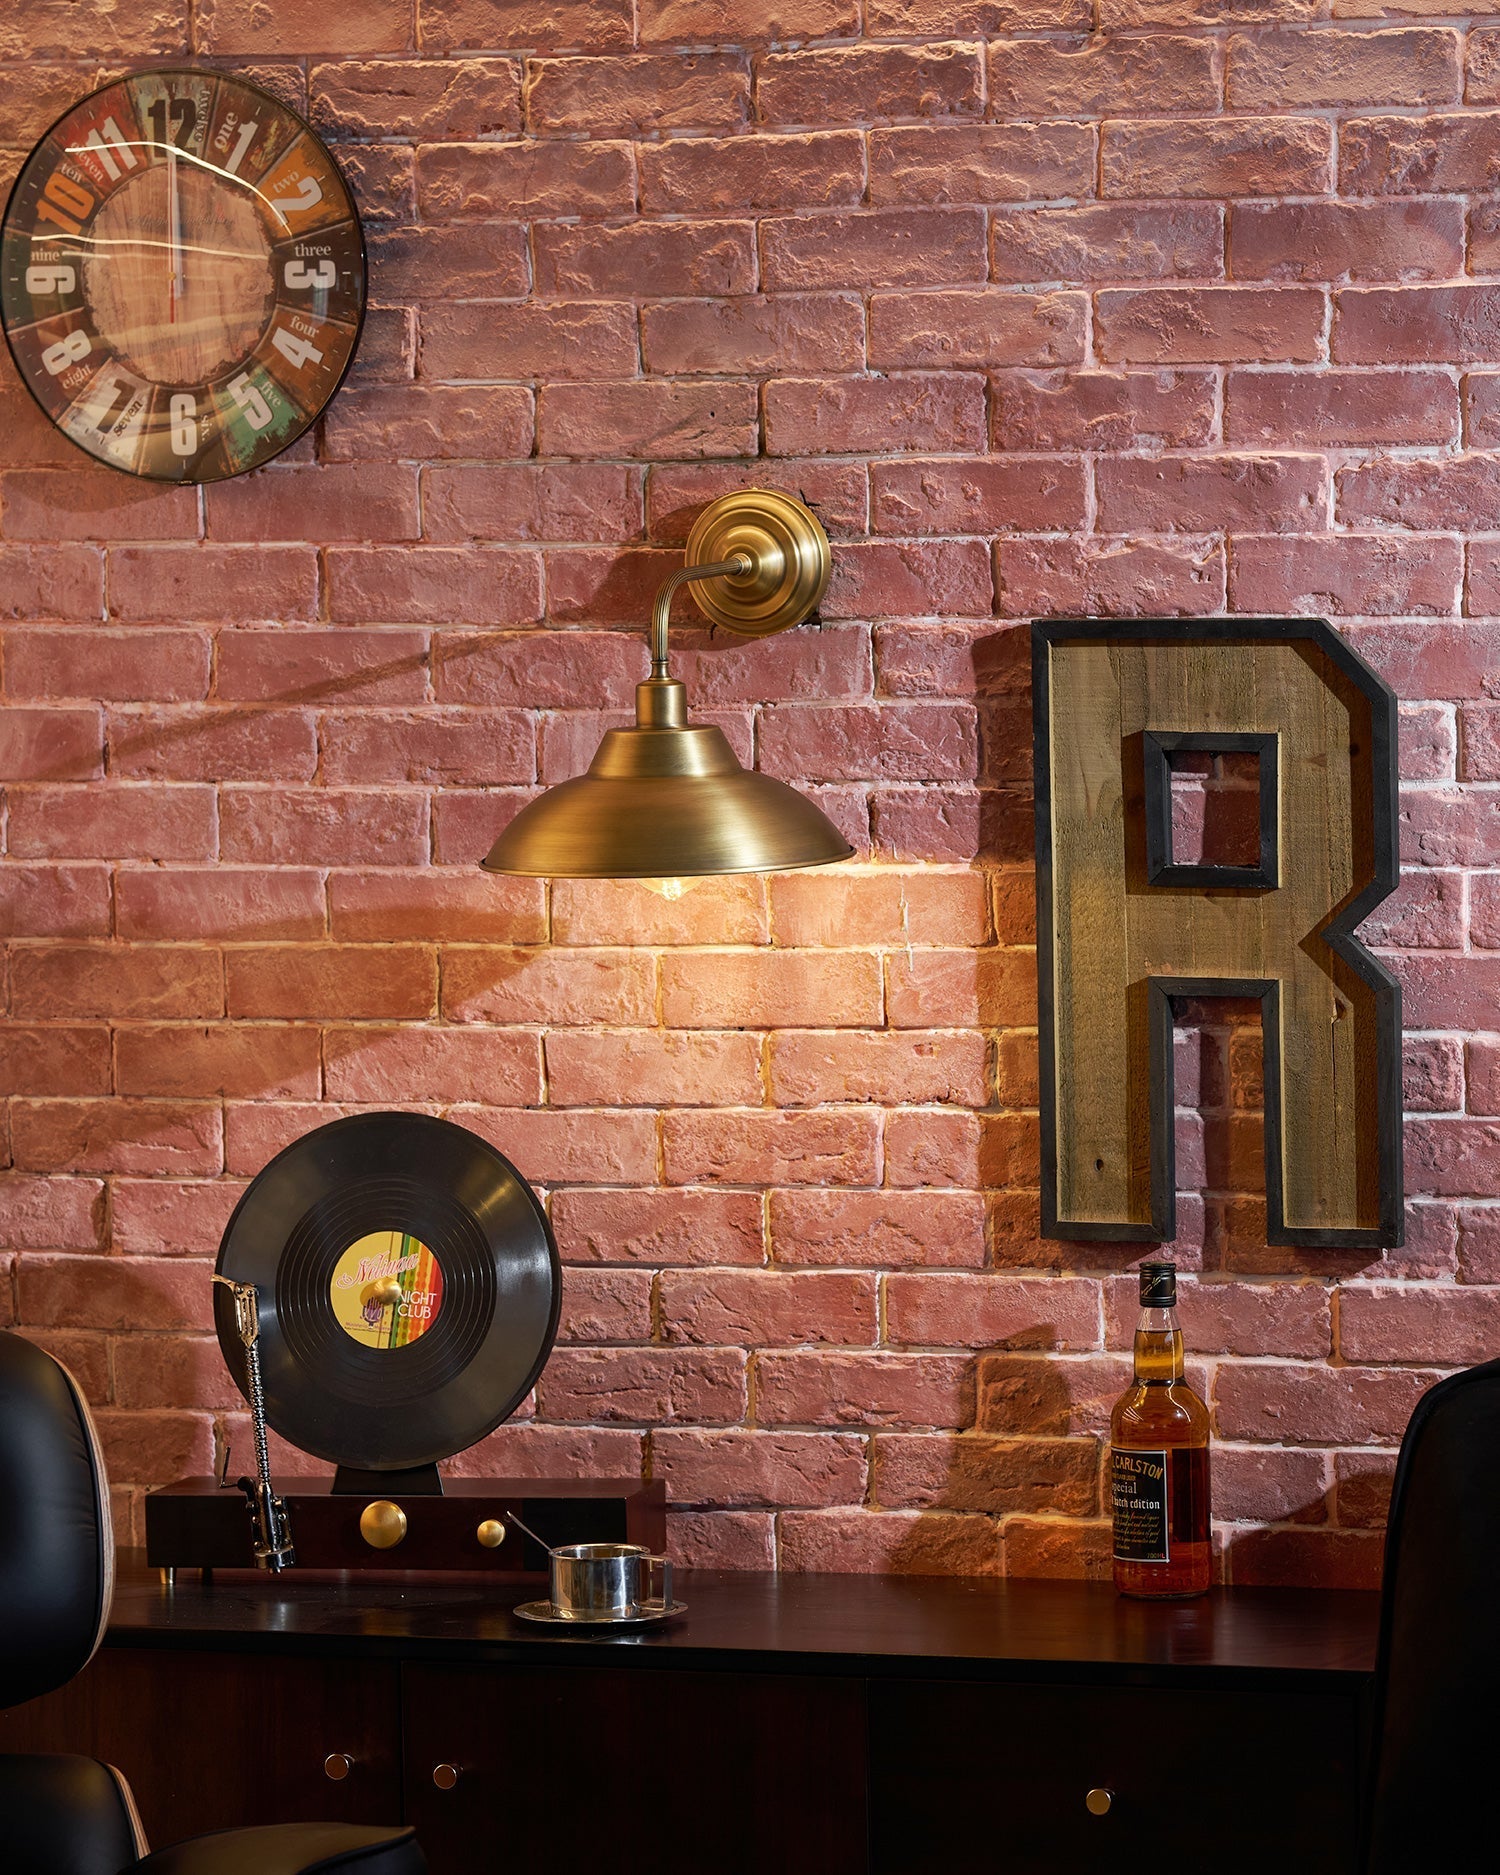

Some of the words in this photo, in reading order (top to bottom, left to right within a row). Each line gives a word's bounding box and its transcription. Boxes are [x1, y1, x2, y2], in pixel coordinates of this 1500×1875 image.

[148, 98, 198, 158] 12
[193, 90, 210, 143] twelve
[214, 112, 239, 150] one
[70, 141, 104, 183] eleven
[86, 115, 138, 183] 11
[224, 121, 259, 175] 1
[60, 163, 82, 184] ten
[272, 170, 300, 194] two
[36, 172, 95, 236] 10
[270, 176, 323, 228] 2
[31, 247, 60, 262] nine
[295, 243, 331, 258] three
[26, 265, 76, 295] 9
[284, 260, 336, 290] 3
[289, 315, 320, 338] four
[41, 329, 92, 376] 8
[272, 327, 324, 370] 4
[62, 363, 94, 390] eight
[259, 380, 282, 407] five
[96, 379, 137, 434] 7
[112, 399, 144, 437] seven
[226, 371, 274, 431] 5
[170, 393, 197, 456] 6
[1032, 617, 1405, 1249] R
[397, 1303, 431, 1319] CLUB
[1129, 1498, 1160, 1510] edition
